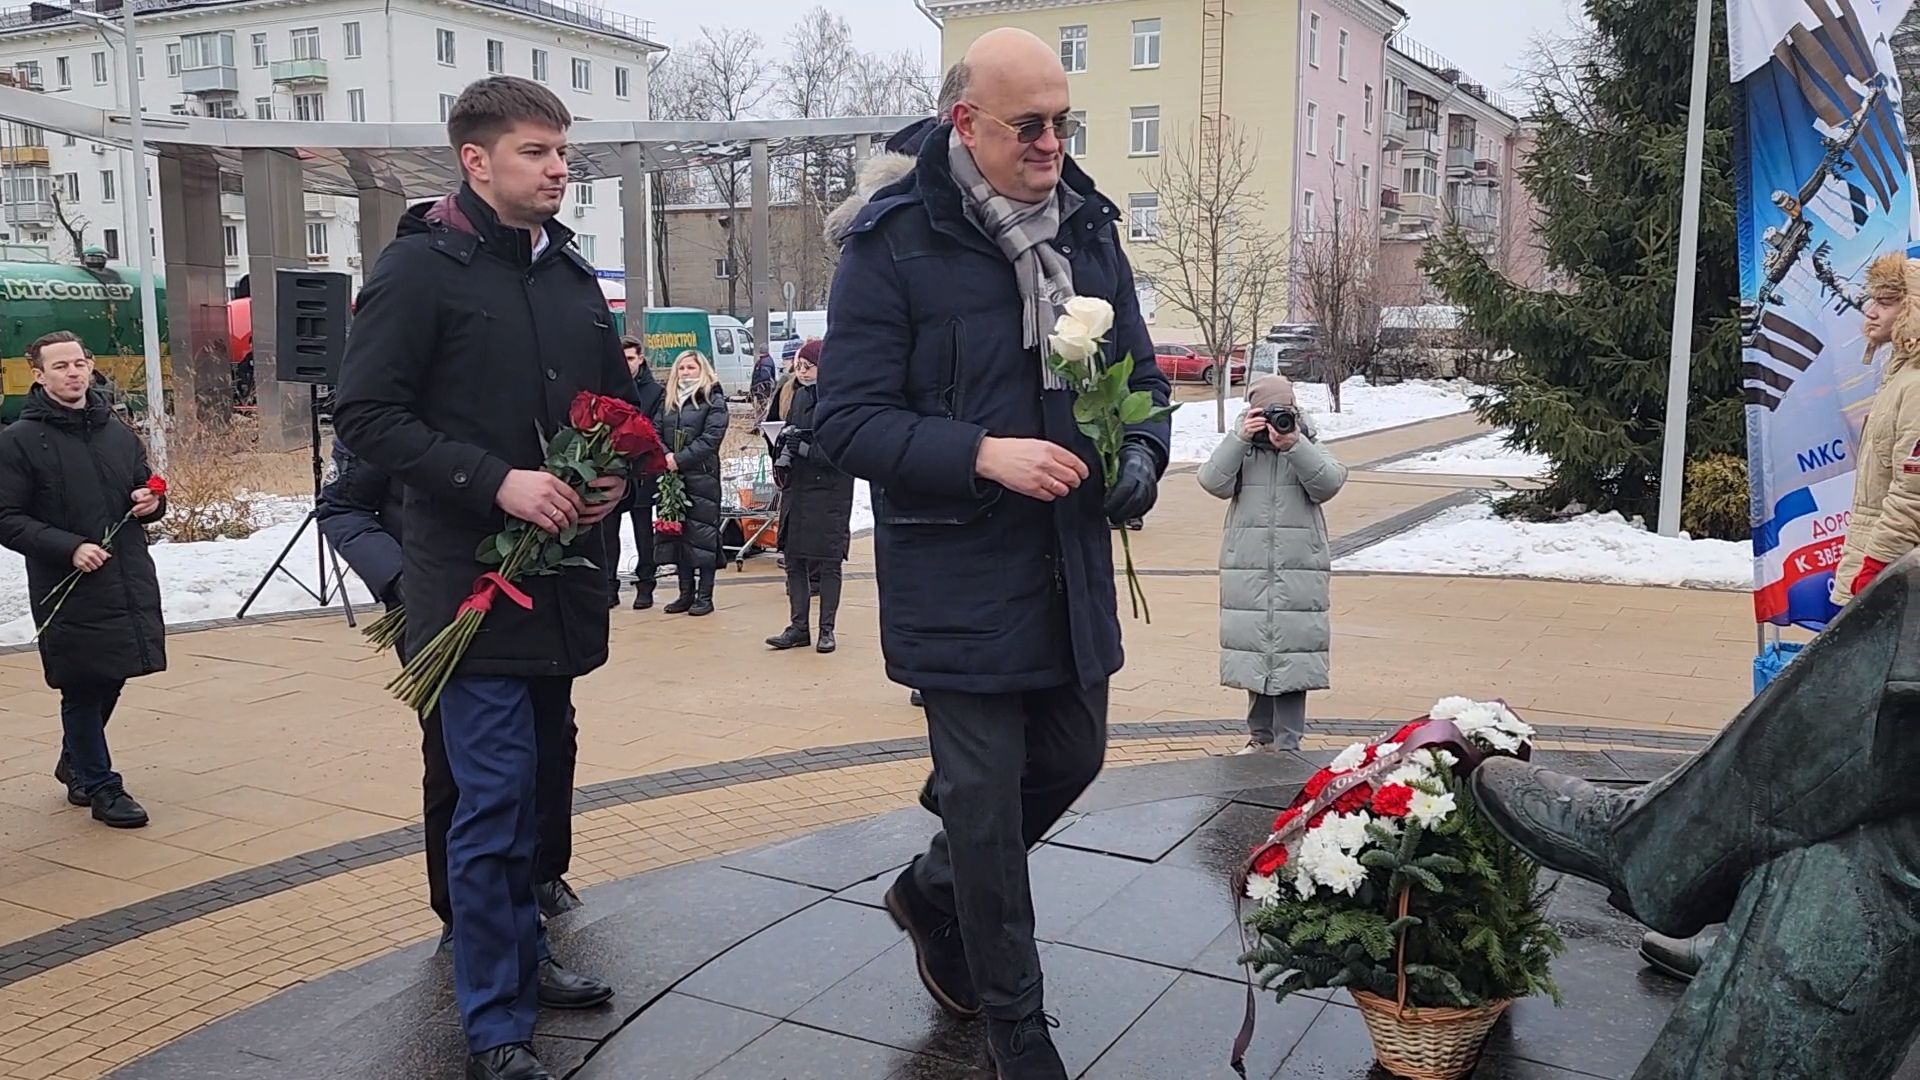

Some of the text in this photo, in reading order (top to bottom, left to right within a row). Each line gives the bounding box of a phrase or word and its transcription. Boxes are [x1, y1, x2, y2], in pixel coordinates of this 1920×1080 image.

[5, 280, 132, 299] Mr.Corner
[1797, 439, 1846, 472] МКС
[1812, 510, 1850, 539] ДОРО
[1794, 554, 1812, 573] К
